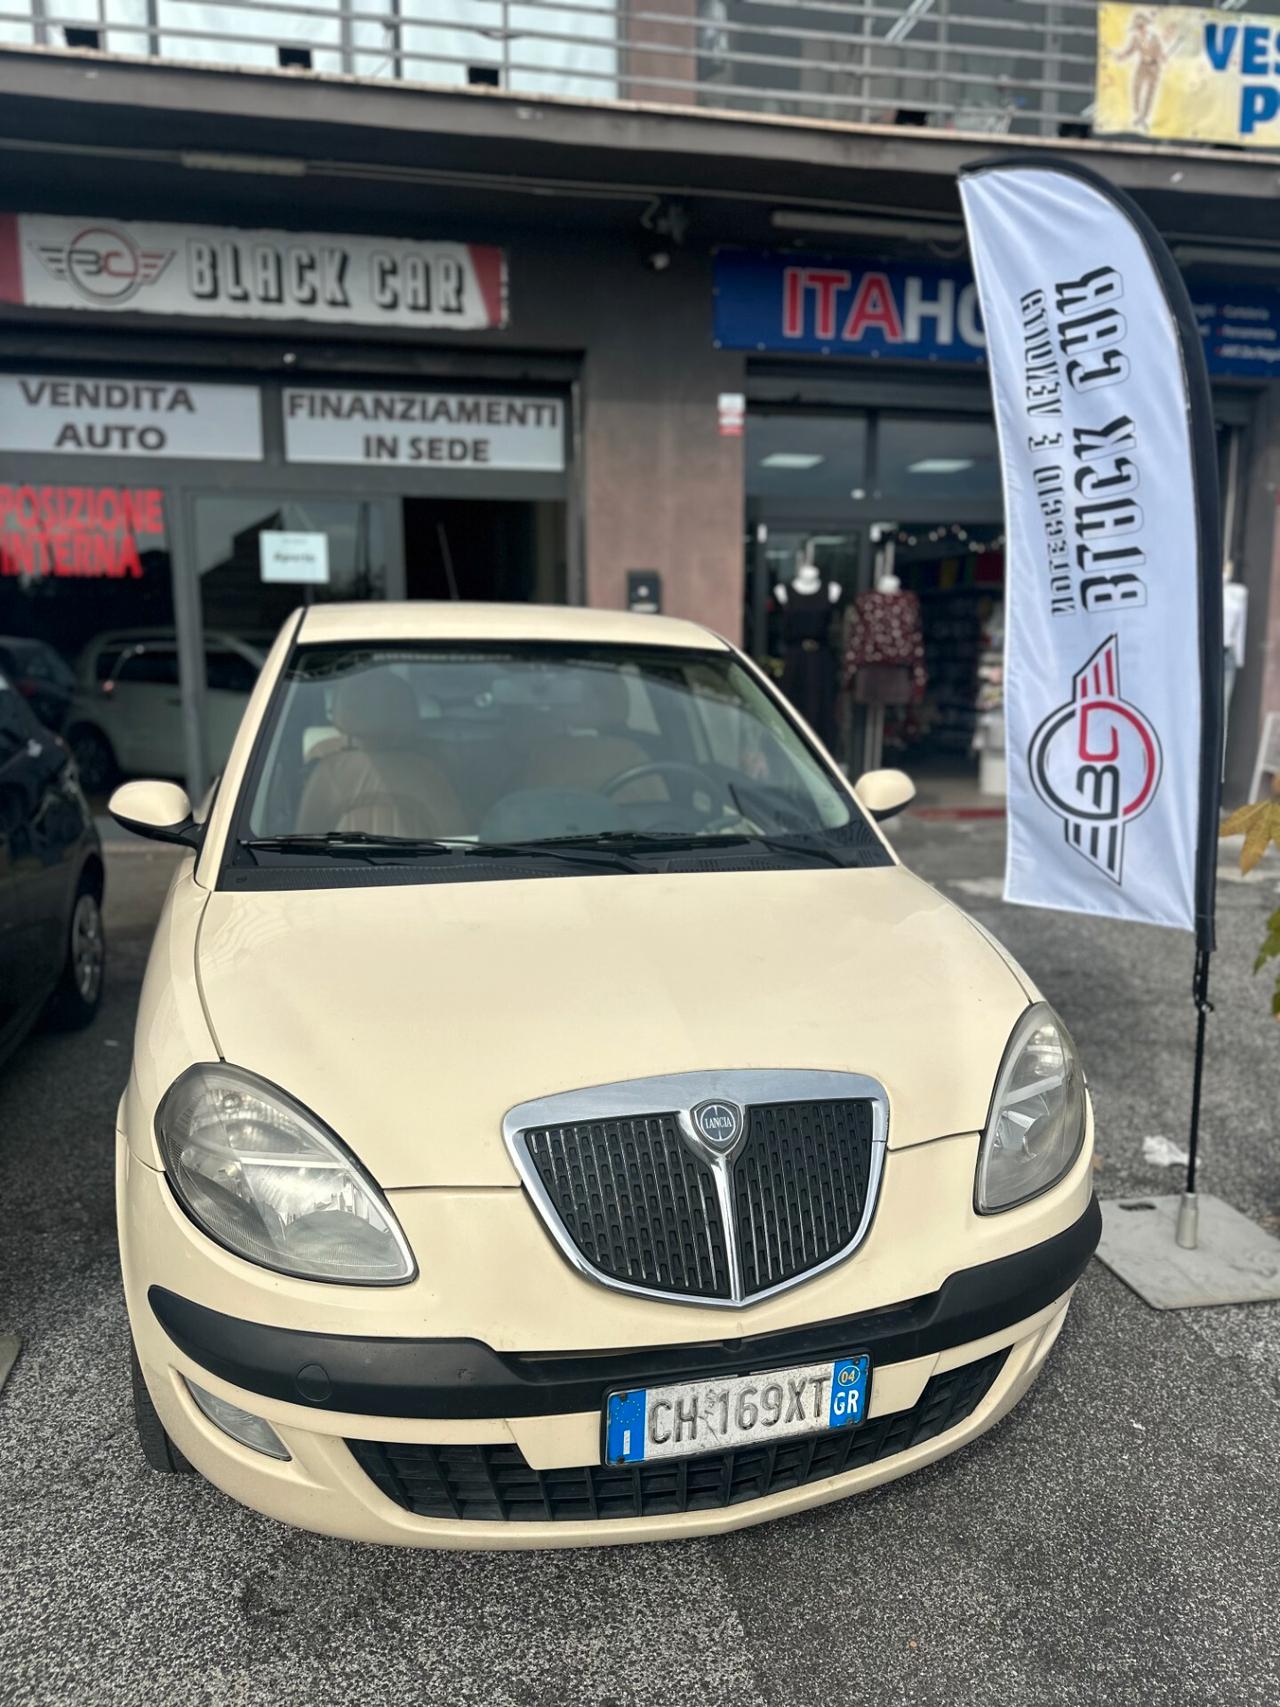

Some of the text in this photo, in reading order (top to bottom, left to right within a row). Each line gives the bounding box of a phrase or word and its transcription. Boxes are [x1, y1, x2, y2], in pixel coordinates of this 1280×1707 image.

[1205, 23, 1280, 75] VE
[185, 237, 464, 314] BLACK CAR
[19, 380, 196, 413] VENDITA
[288, 394, 557, 428] FINANZIAMENTI
[55, 422, 167, 450] AUTO
[364, 435, 490, 462] IN SEDE
[704, 1116, 732, 1129] LANCIA
[840, 1368, 856, 1384] 04
[833, 1389, 859, 1416] GR
